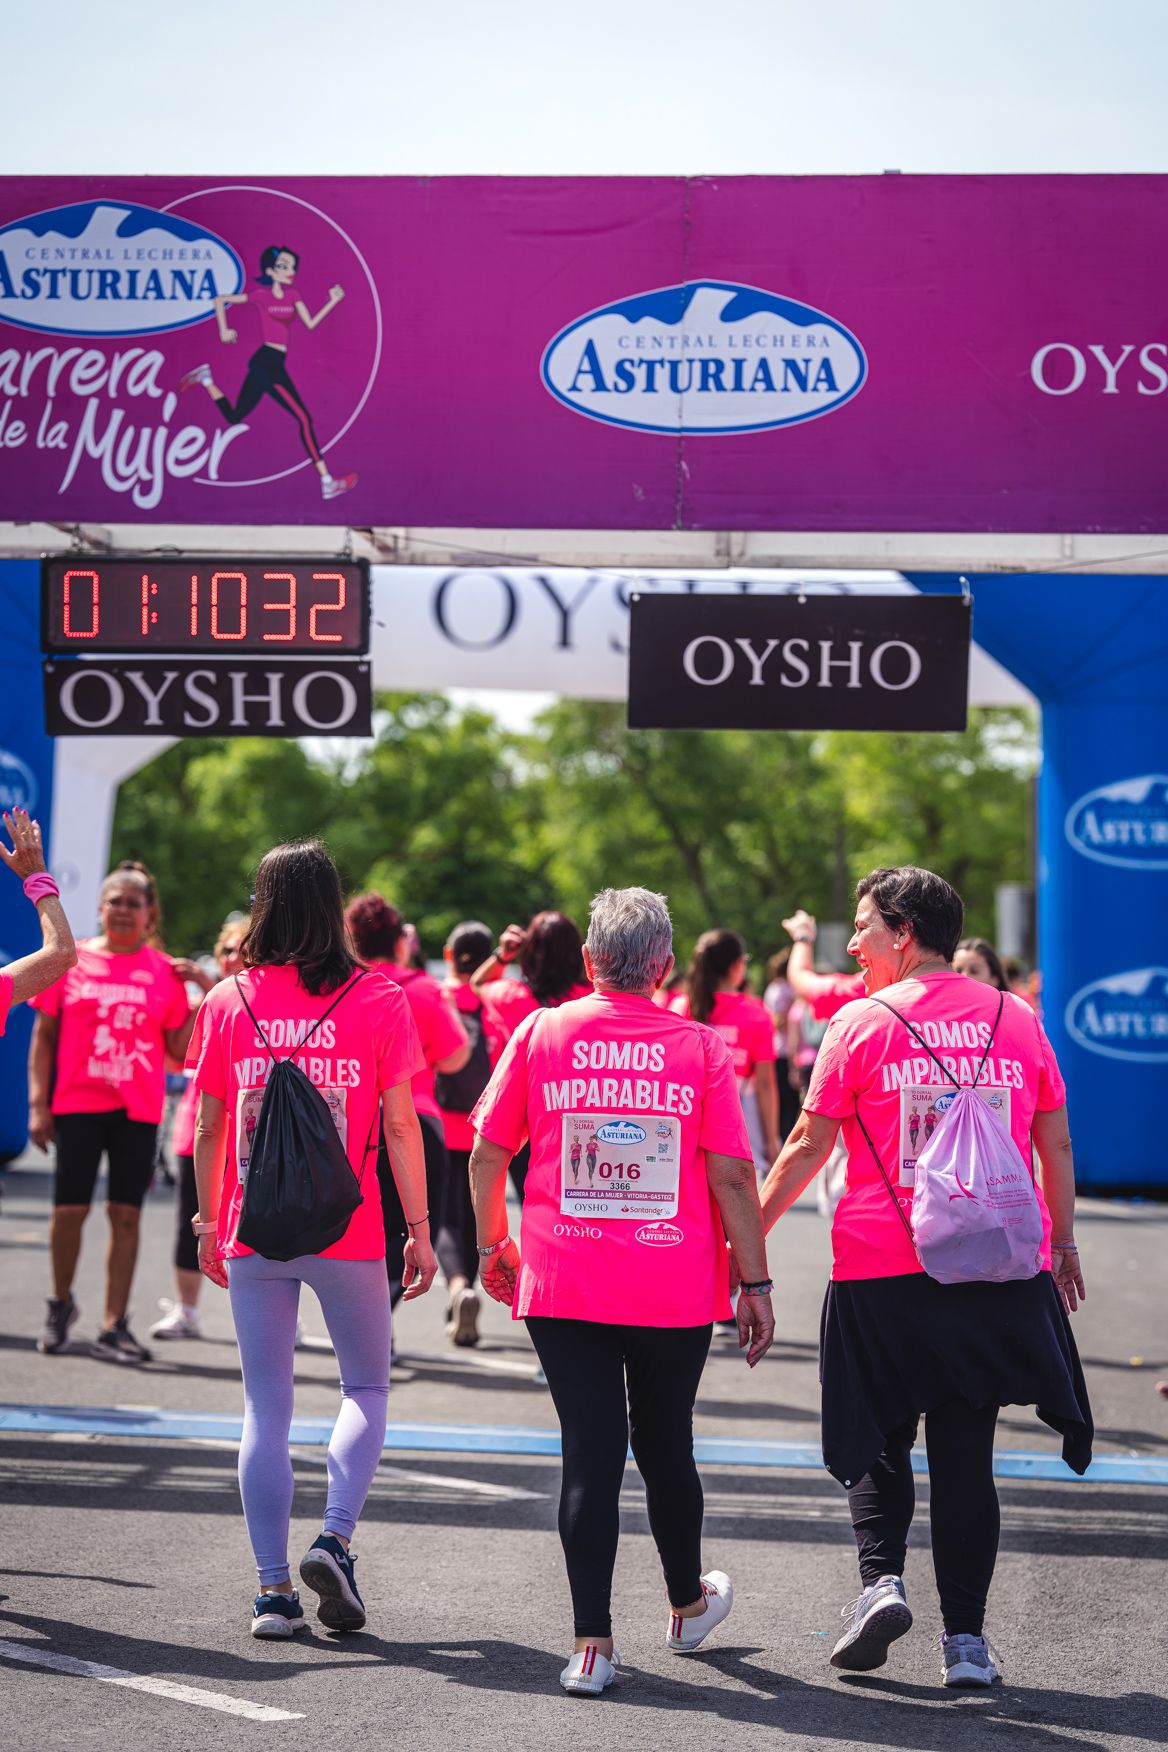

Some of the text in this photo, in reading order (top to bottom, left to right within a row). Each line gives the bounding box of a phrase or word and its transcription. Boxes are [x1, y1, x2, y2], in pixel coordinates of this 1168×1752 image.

[25, 247, 213, 262] CENTRAL LECHERA
[618, 335, 830, 349] CENTRAL LECHERA
[566, 338, 841, 394] ASTURIANA
[37, 398, 68, 449] la
[58, 392, 250, 509] Mujer
[683, 635, 921, 690] OYSHO
[59, 669, 358, 730] OYSHO
[254, 1018, 336, 1050] SOMOS
[906, 1021, 994, 1049] SOMOS
[571, 1040, 666, 1073] SOMOS
[881, 1056, 1024, 1092] IMPARABLES
[541, 1077, 695, 1116] IMPARABLES
[911, 1094, 933, 1102] SUMA
[600, 1128, 643, 1140] ASTURIANA
[599, 1162, 640, 1179] 016
[610, 1182, 631, 1191] 3366
[574, 1203, 663, 1214] OYSHO Santander
[553, 1224, 602, 1239] OYSHO
[639, 1230, 681, 1241] ASTURIANA
